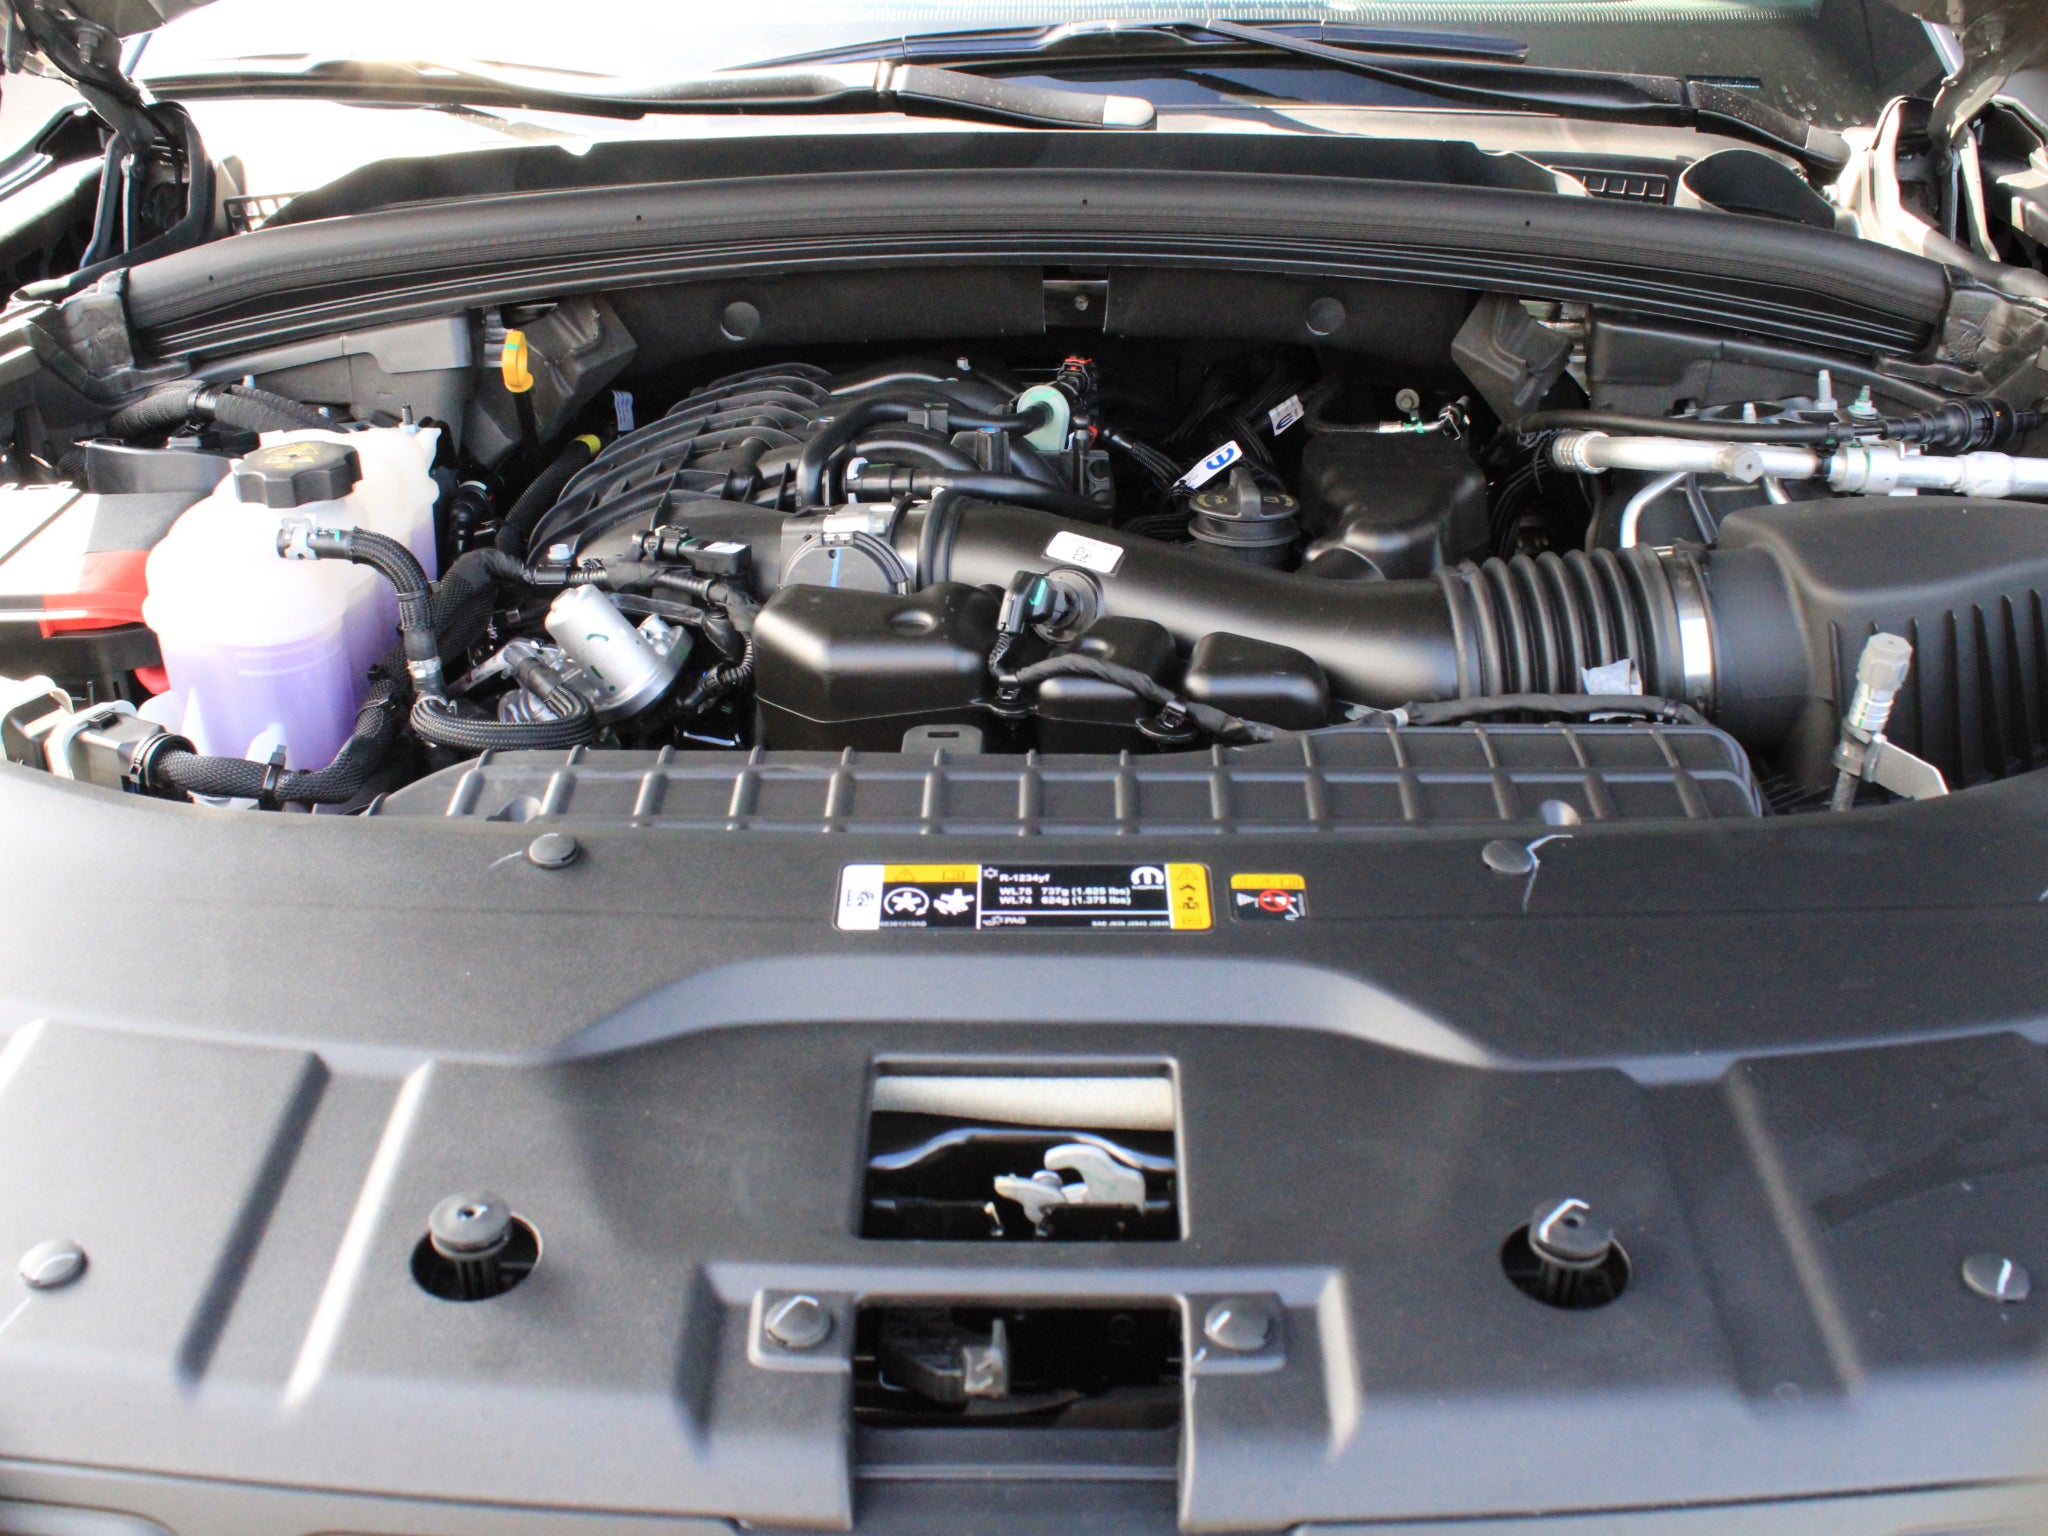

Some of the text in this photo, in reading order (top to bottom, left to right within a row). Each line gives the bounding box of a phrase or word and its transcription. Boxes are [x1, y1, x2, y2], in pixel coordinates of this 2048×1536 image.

[999, 873, 1050, 884] R-1234yf
[1041, 886, 1069, 897] 737g
[1108, 886, 1131, 896] lbs)
[999, 895, 1033, 905] WL74
[1108, 895, 1132, 906] lbs)
[1005, 916, 1027, 925] PAG
